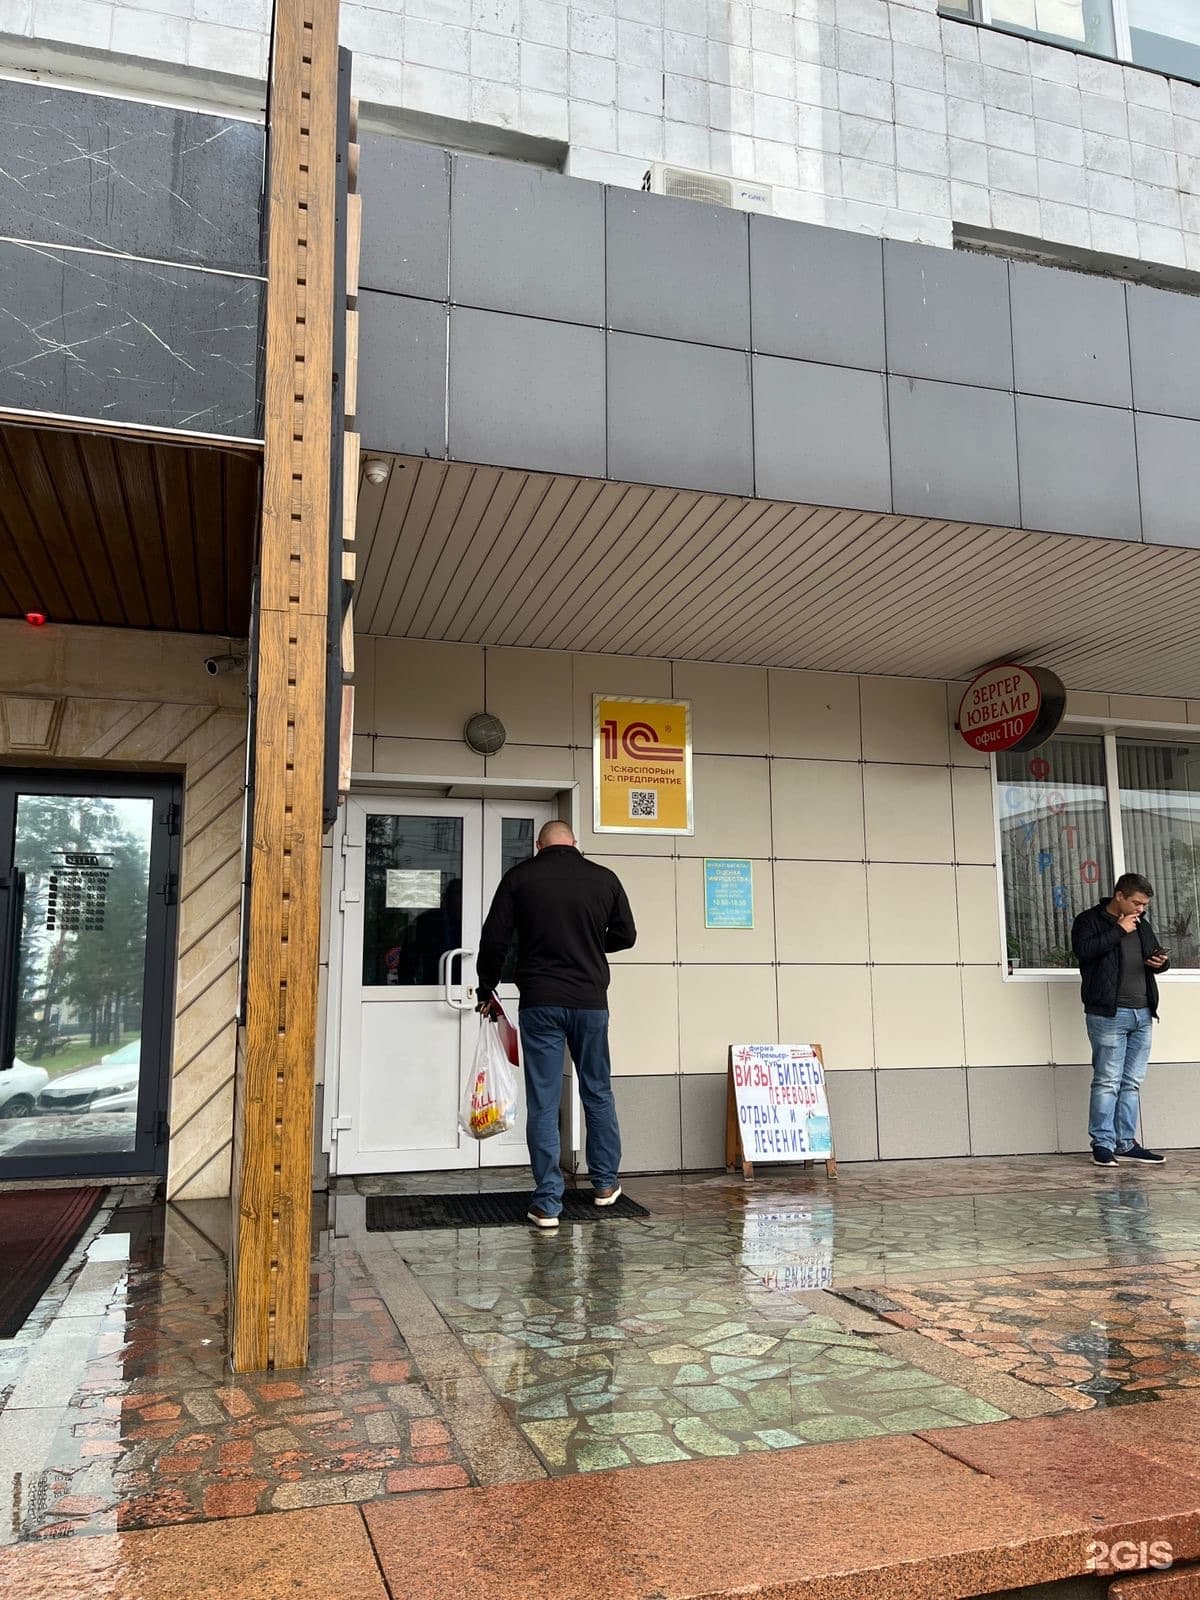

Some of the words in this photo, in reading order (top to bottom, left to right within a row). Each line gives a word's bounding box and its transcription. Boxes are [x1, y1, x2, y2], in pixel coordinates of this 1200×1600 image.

[973, 675, 1020, 705] ЗЕРГЕР
[967, 692, 1030, 726] ЮВЕЛИР
[976, 729, 1000, 746] офис
[1002, 718, 1024, 739] 110
[610, 765, 674, 775] 1С:КӘСІПОРЫН
[617, 775, 682, 784] ПРЕДПРИЯТИЕ
[735, 1064, 772, 1086] ВИЗЫ
[776, 1063, 824, 1086] БИЛЕТЫ
[768, 1086, 820, 1107] ПЕРЕВОДЫ
[740, 1105, 779, 1128] ОТДЫХ
[754, 1129, 806, 1153] ЛЕЧЕНИЕ
